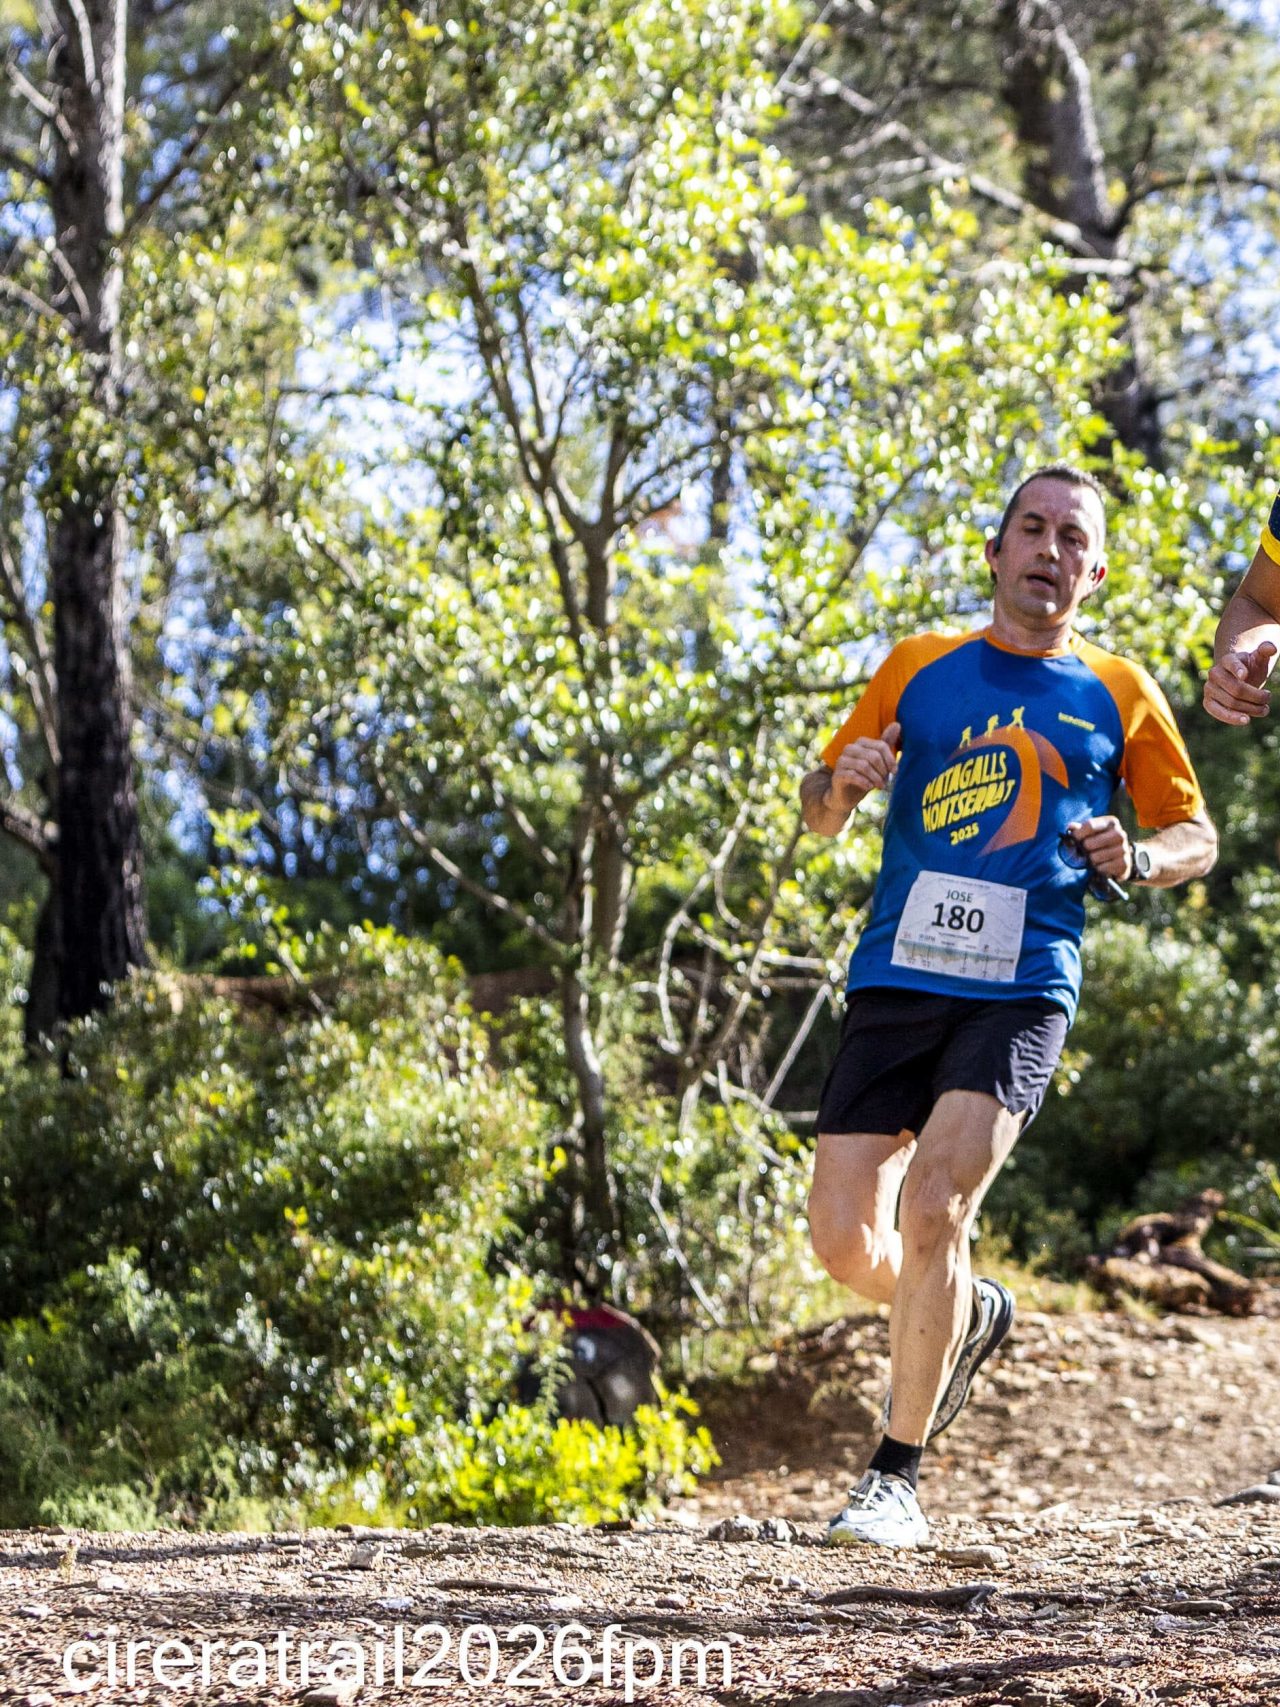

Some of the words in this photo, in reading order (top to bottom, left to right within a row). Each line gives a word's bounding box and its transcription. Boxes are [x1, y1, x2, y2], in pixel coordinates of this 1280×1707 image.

[922, 751, 1008, 807] MATAGALLS
[922, 779, 1016, 833] MONTSERRAT
[950, 822, 980, 846] 2025
[946, 888, 974, 903] JOSE
[931, 902, 985, 933] 180
